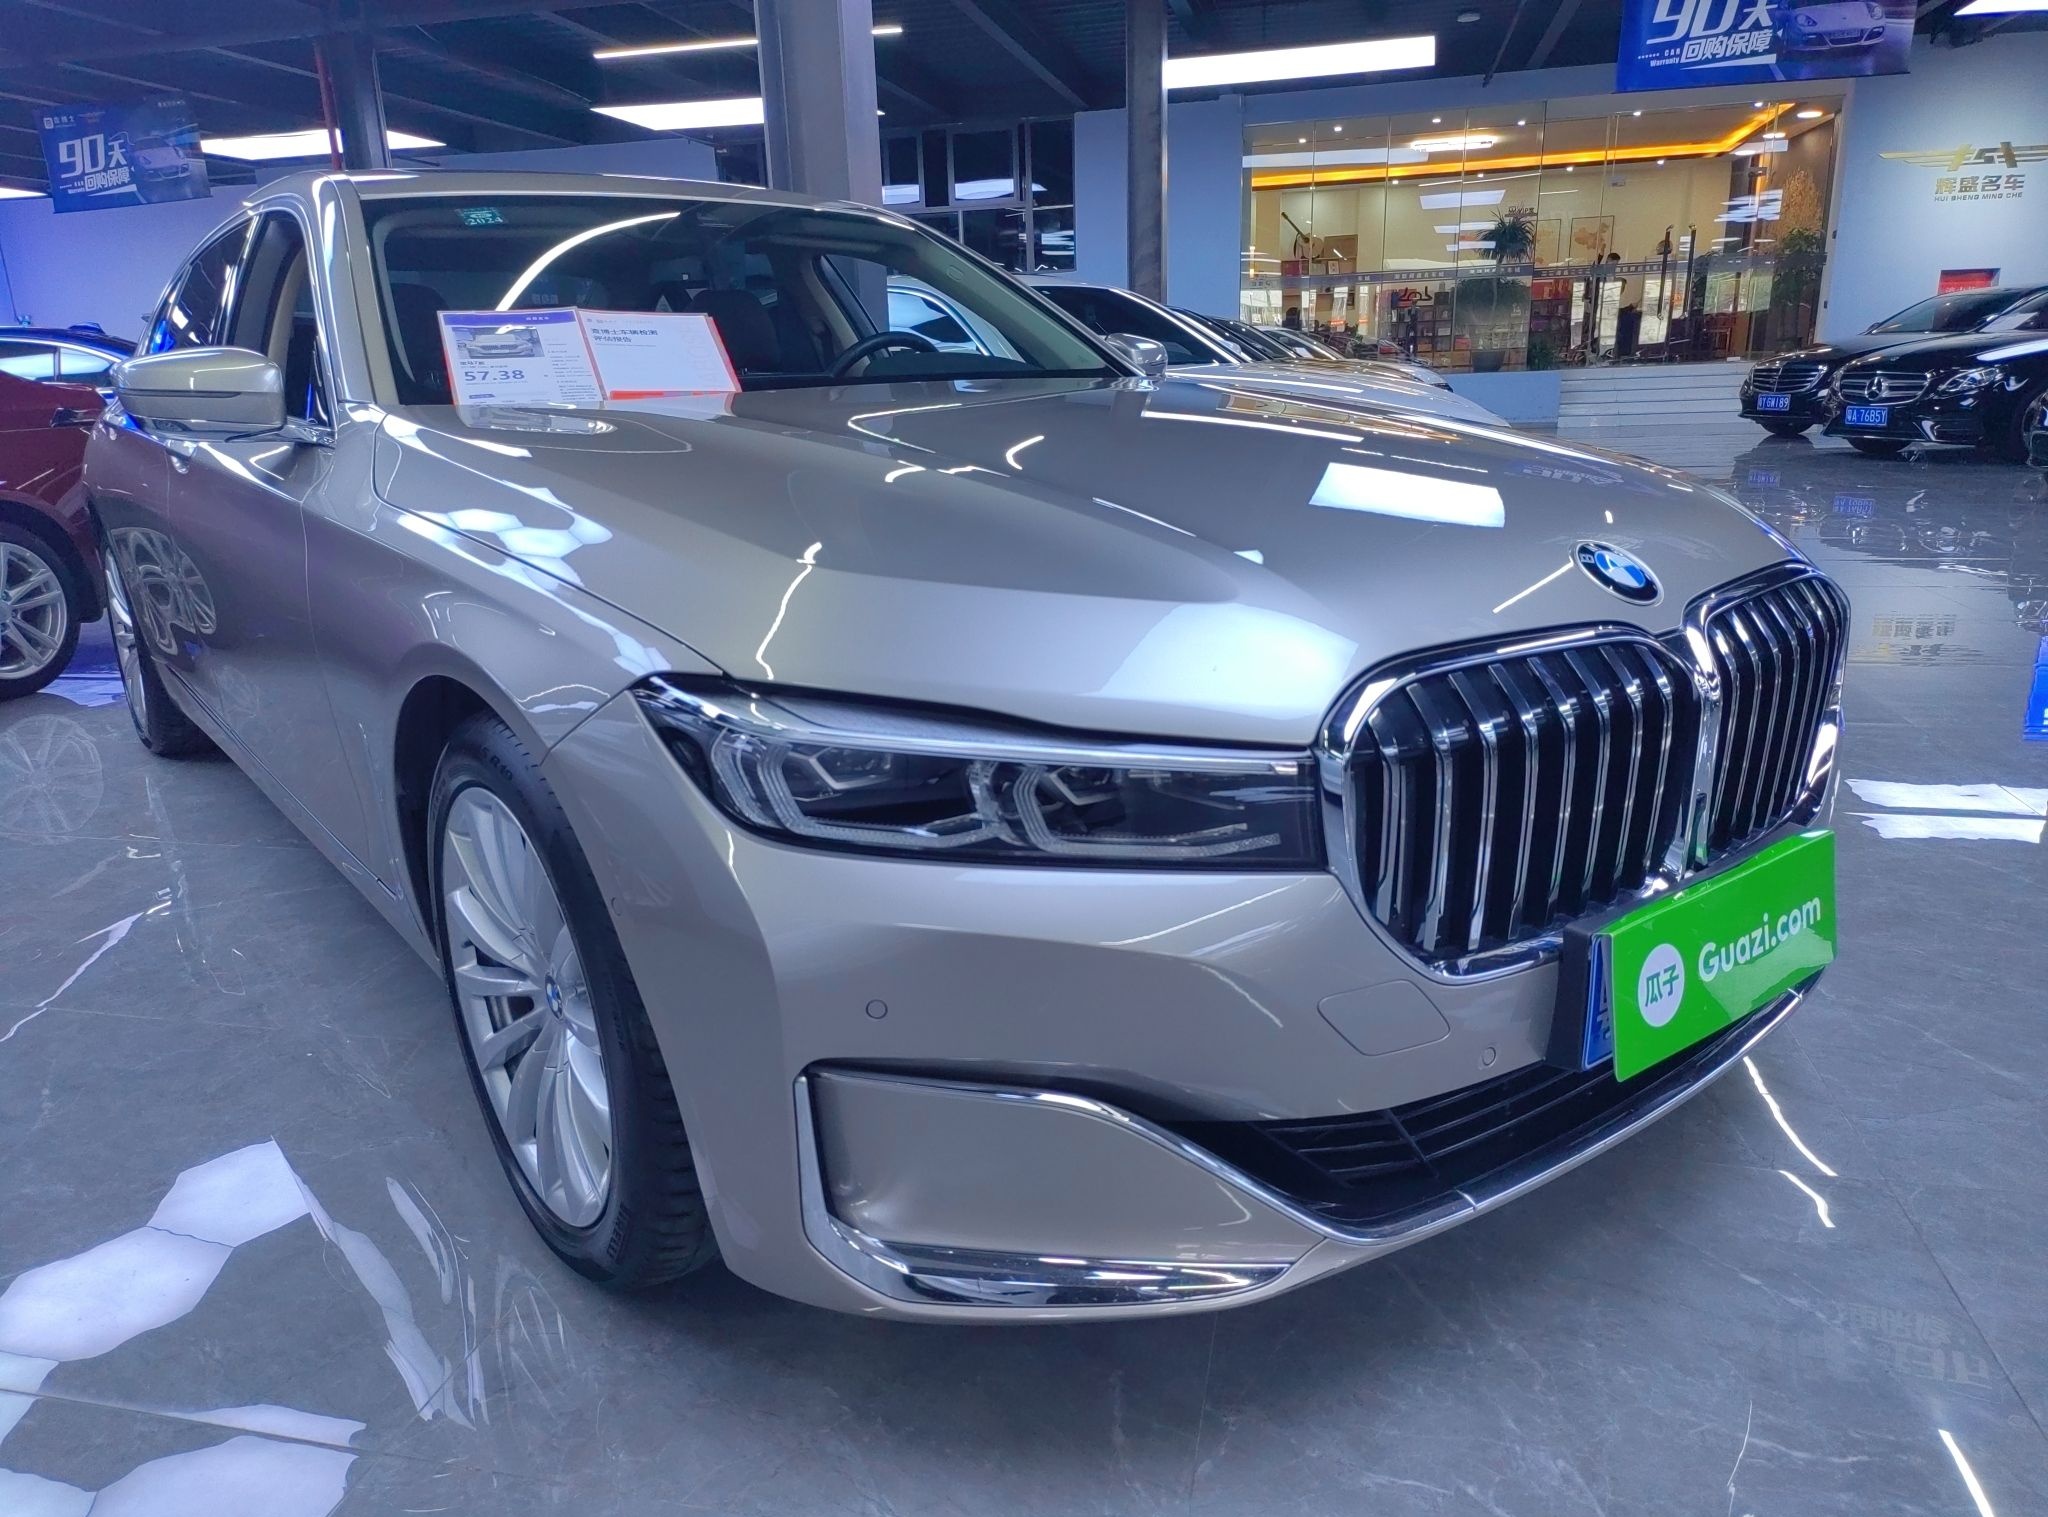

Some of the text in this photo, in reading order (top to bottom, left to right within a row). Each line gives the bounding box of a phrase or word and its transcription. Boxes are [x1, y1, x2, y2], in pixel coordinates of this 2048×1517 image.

[1664, 47, 1681, 57] CAR
[1680, 29, 1773, 63] 回购保障
[1650, 57, 1680, 67] Warranty
[58, 134, 127, 178] 90天
[84, 166, 130, 192] 回购保障
[1935, 174, 2026, 195] 辉盛名车
[2005, 191, 2023, 199] CHE
[464, 370, 525, 382] 57.38
[1699, 897, 1821, 982] Guazi.com
[1645, 964, 1680, 1008] 瓜子
